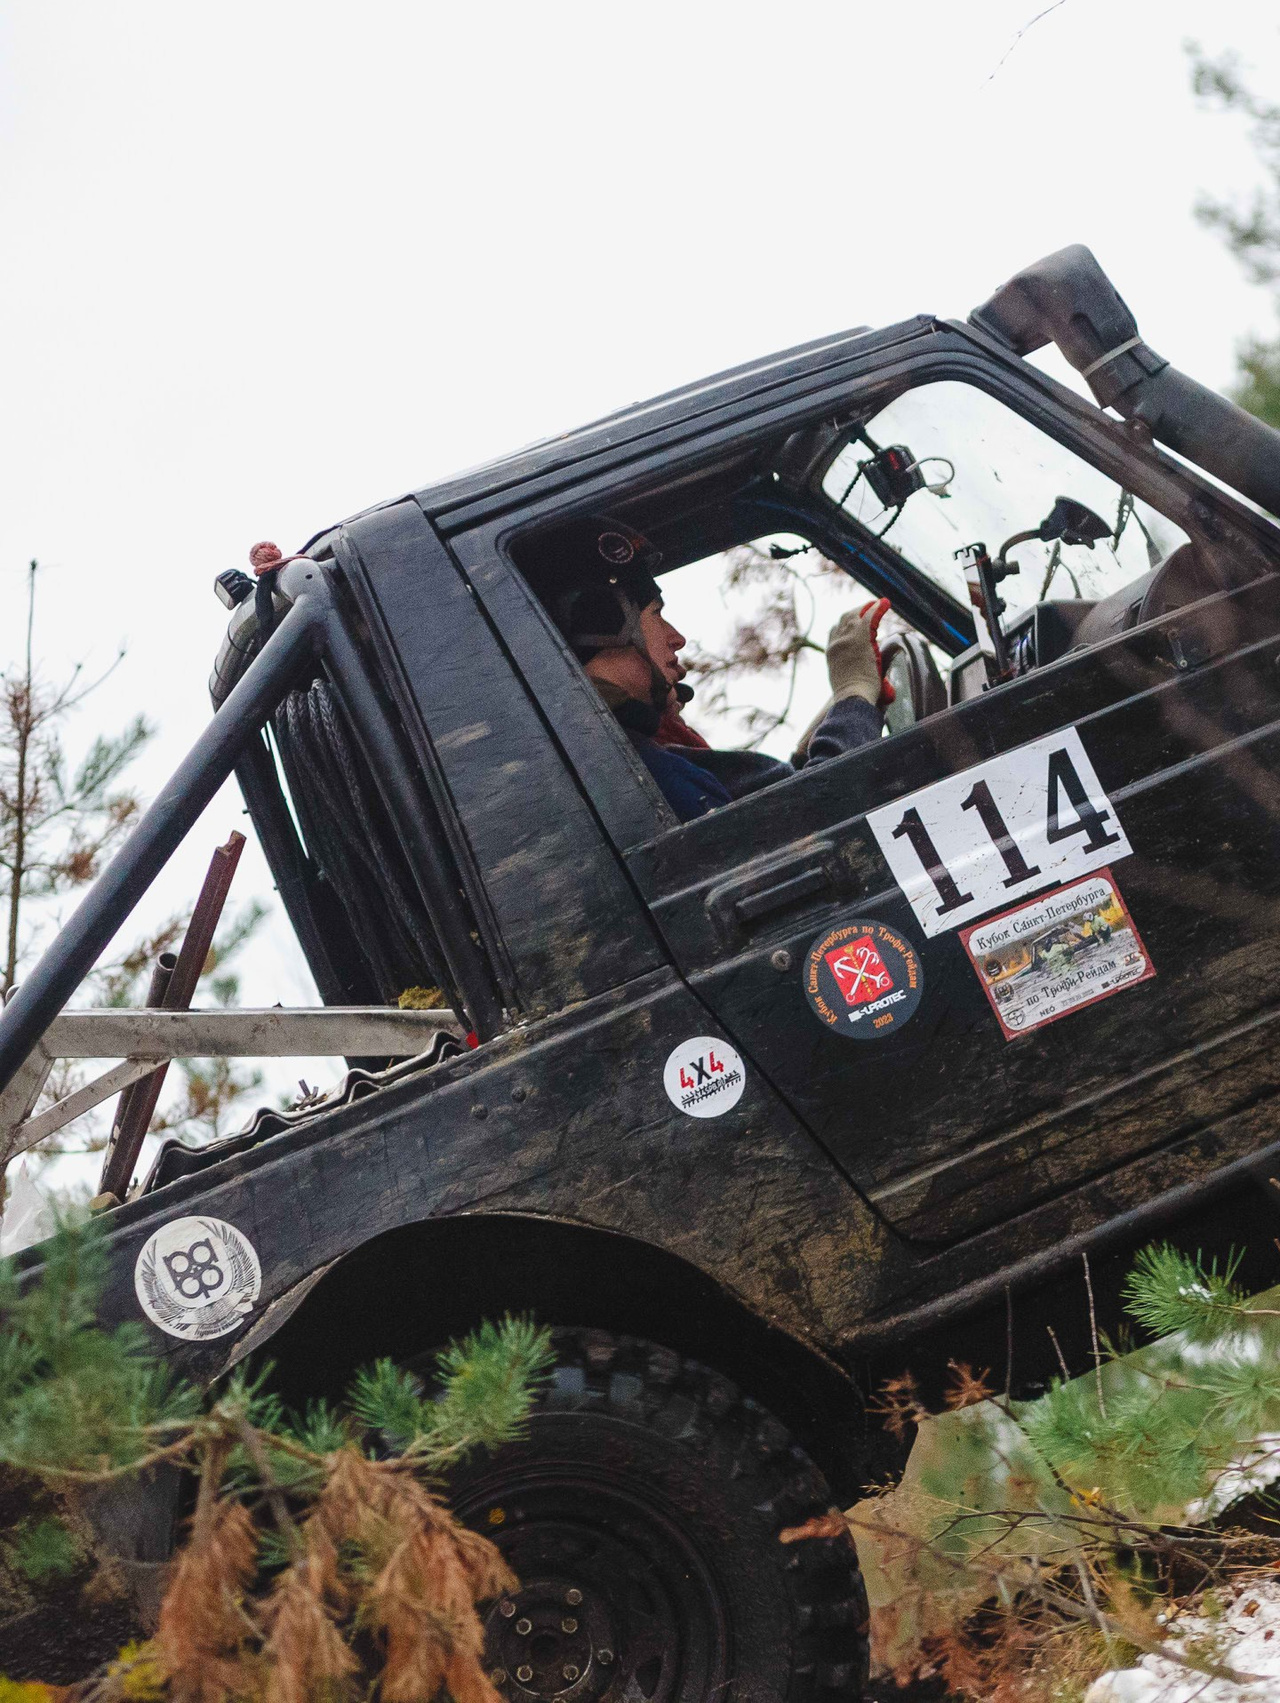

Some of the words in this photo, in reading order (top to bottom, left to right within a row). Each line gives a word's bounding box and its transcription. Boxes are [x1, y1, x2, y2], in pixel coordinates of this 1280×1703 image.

[892, 747, 1121, 917] 114
[862, 925, 874, 934] по
[976, 928, 1011, 950] Кубок
[1012, 887, 1106, 934] Санкт-Петербурга
[808, 925, 858, 994] Санкт-Петербурга
[1026, 995, 1039, 1007] по
[1041, 961, 1117, 999] Трофи-Рейдам
[814, 996, 838, 1025] Кубок
[872, 1012, 895, 1029] 2023
